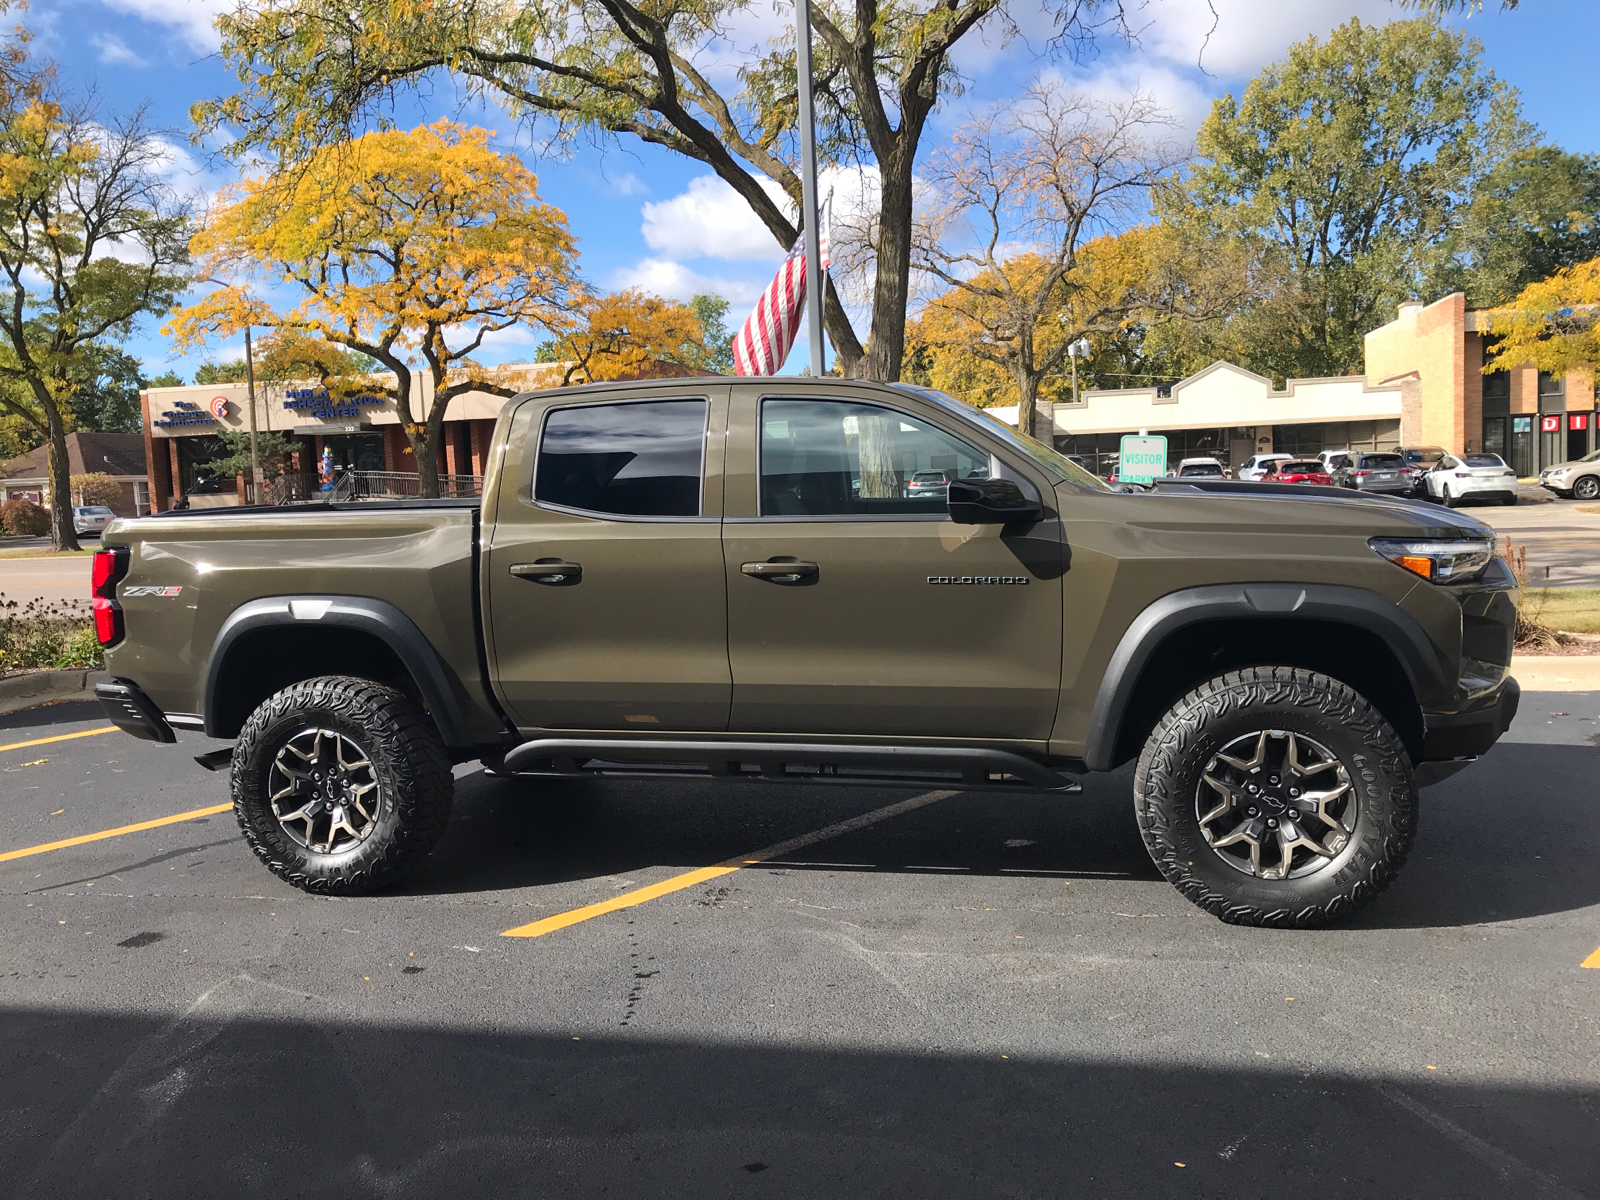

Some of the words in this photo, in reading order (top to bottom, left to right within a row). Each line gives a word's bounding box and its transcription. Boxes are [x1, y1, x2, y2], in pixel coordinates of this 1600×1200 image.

[283, 396, 385, 409] REHABILTION
[161, 410, 206, 418] Chicago
[310, 407, 359, 418] CENTER
[153, 418, 215, 428] Lighthouse
[1125, 453, 1163, 465] VISITOR
[1123, 474, 1162, 484] PARKI
[926, 576, 1028, 585] COLORADO
[123, 586, 182, 597] ZR2
[1331, 753, 1386, 888] GOODYEAR
